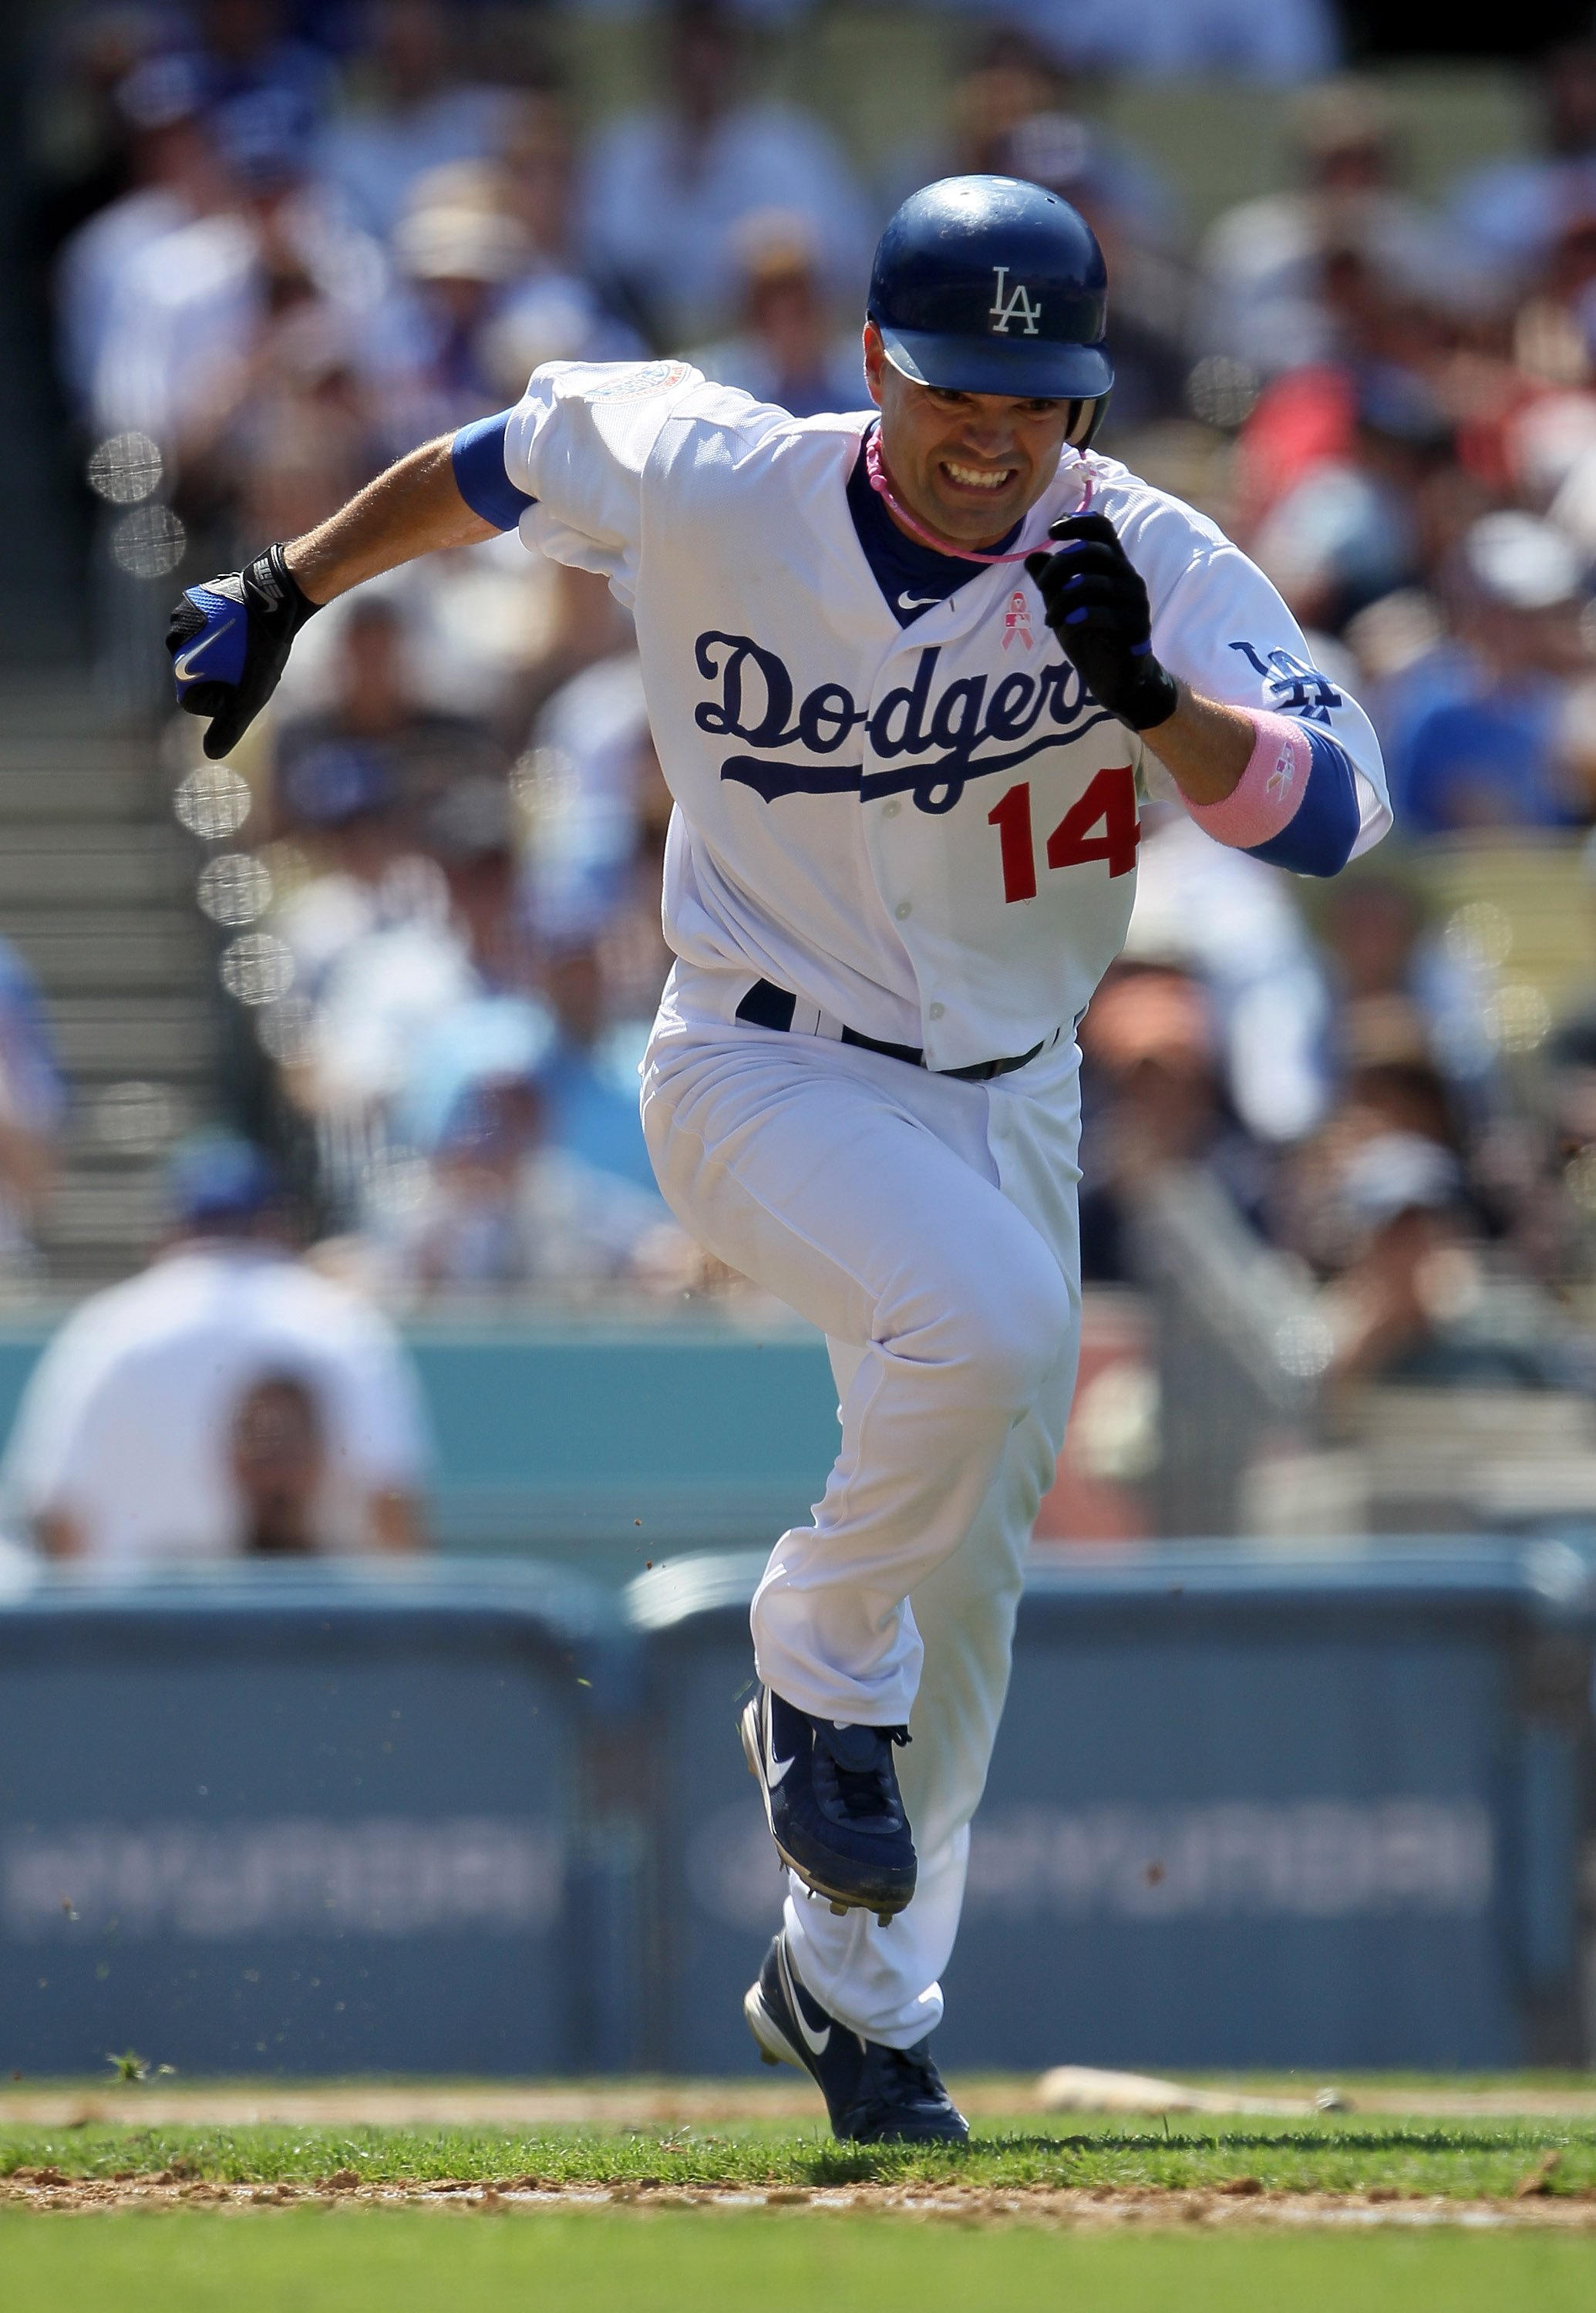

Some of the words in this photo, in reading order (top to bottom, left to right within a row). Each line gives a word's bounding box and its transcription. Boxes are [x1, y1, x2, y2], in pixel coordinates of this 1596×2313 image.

[990, 266, 1042, 334] LA
[695, 630, 1101, 814] Dodger
[988, 764, 1141, 903] 14
